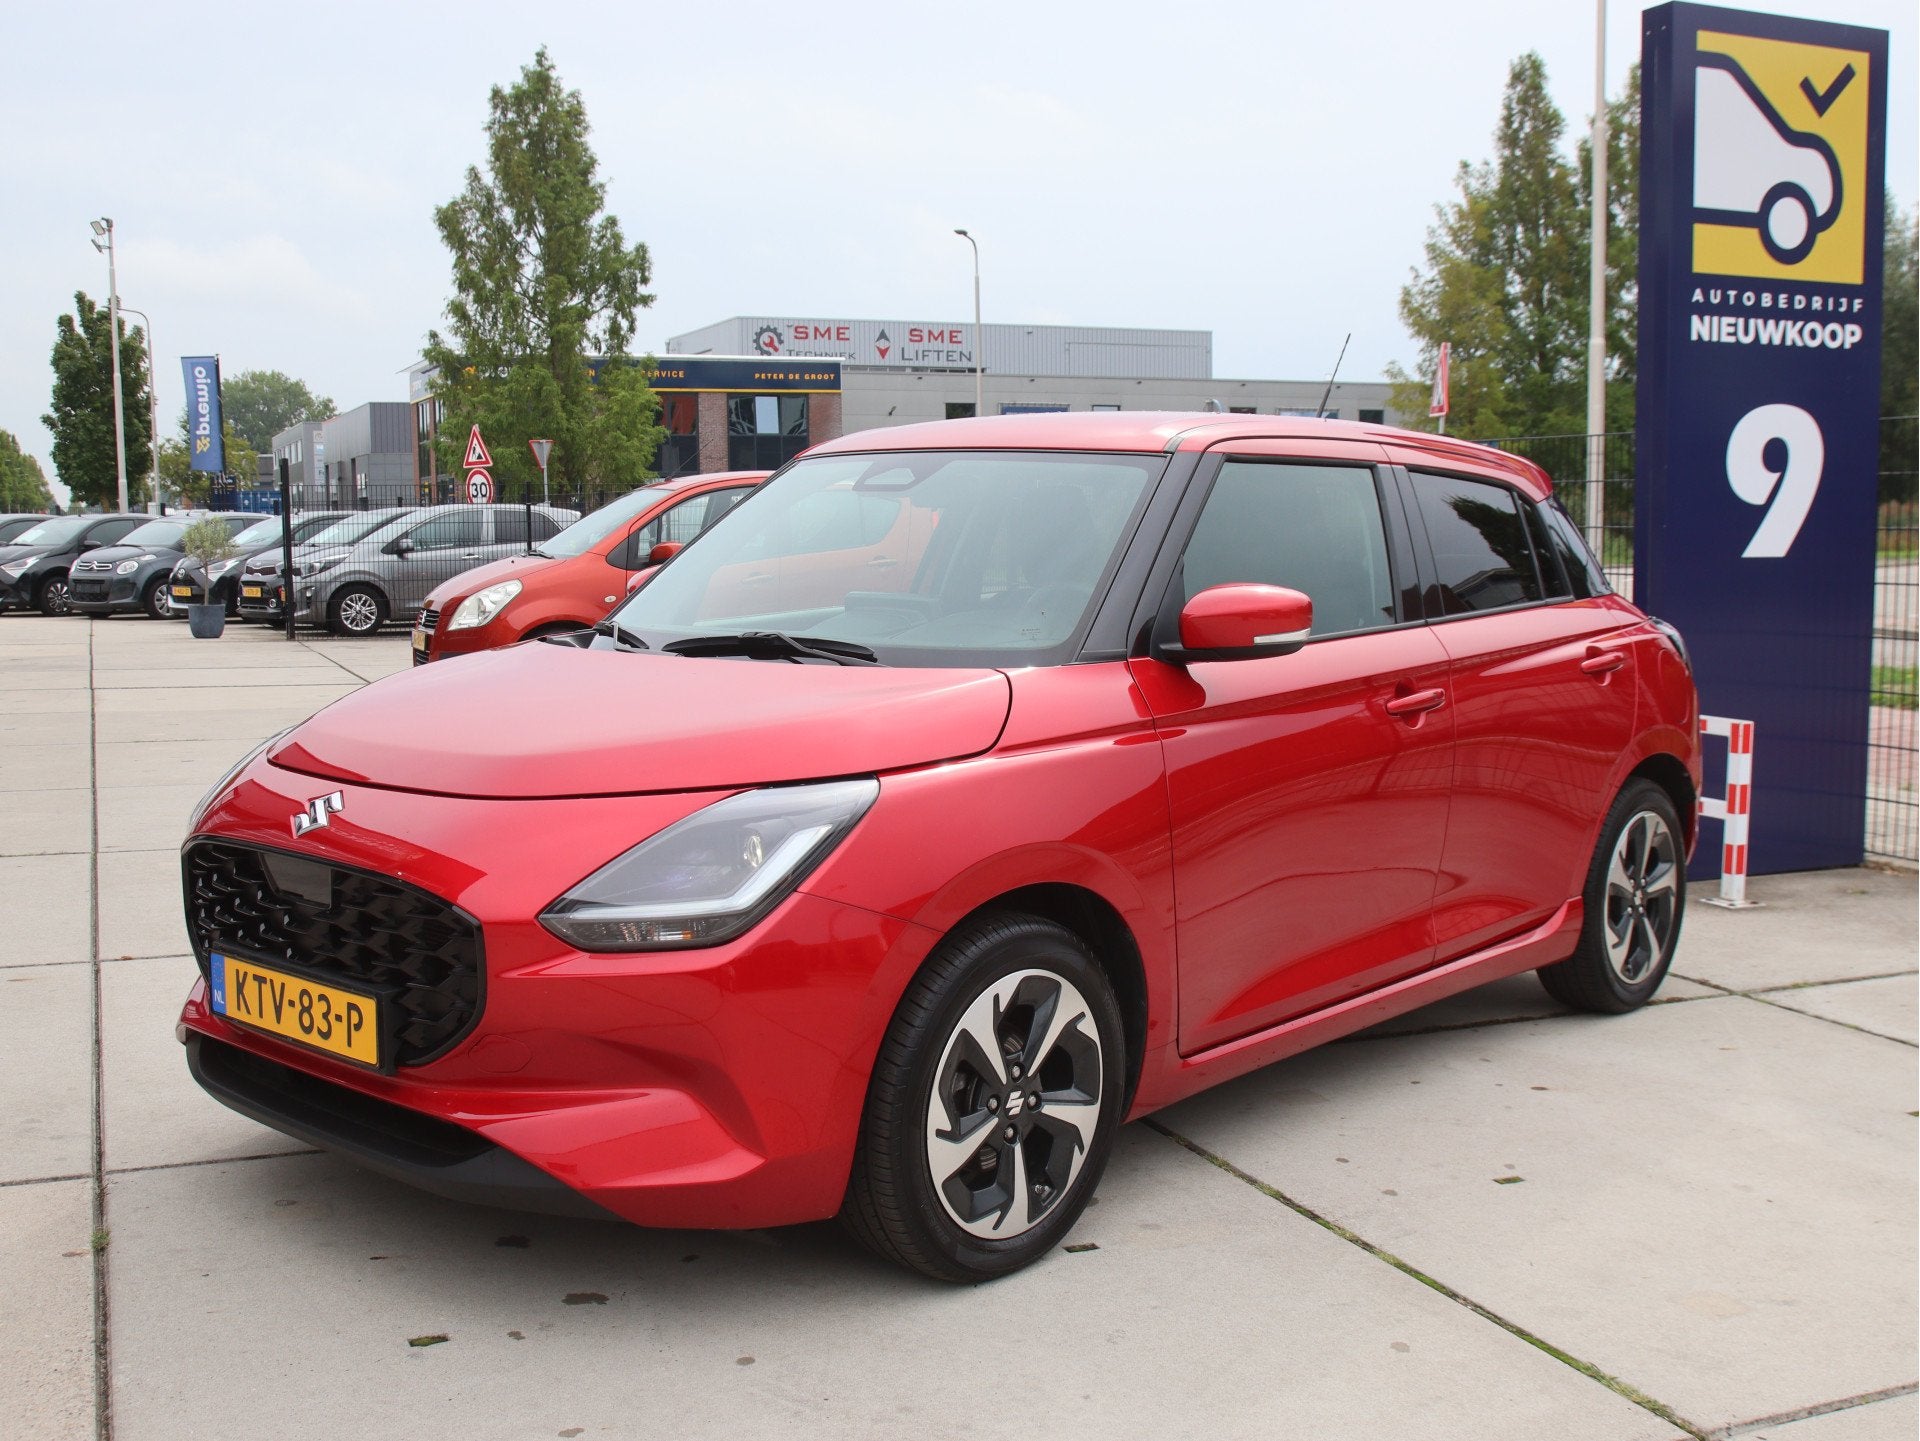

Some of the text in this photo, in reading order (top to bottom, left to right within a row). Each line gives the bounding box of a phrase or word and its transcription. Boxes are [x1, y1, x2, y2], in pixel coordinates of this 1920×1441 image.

[1691, 287, 1864, 313] AUTOBEDRIJF
[794, 325, 850, 341] SME
[908, 328, 963, 344] SME
[1690, 314, 1863, 350] NIEUWKOOP
[786, 349, 856, 360] TECHNIEK
[901, 346, 972, 363] LIFTEN
[1725, 403, 1825, 559] 9
[471, 482, 488, 498] 30
[214, 968, 364, 1049] NL KTV-83-P
